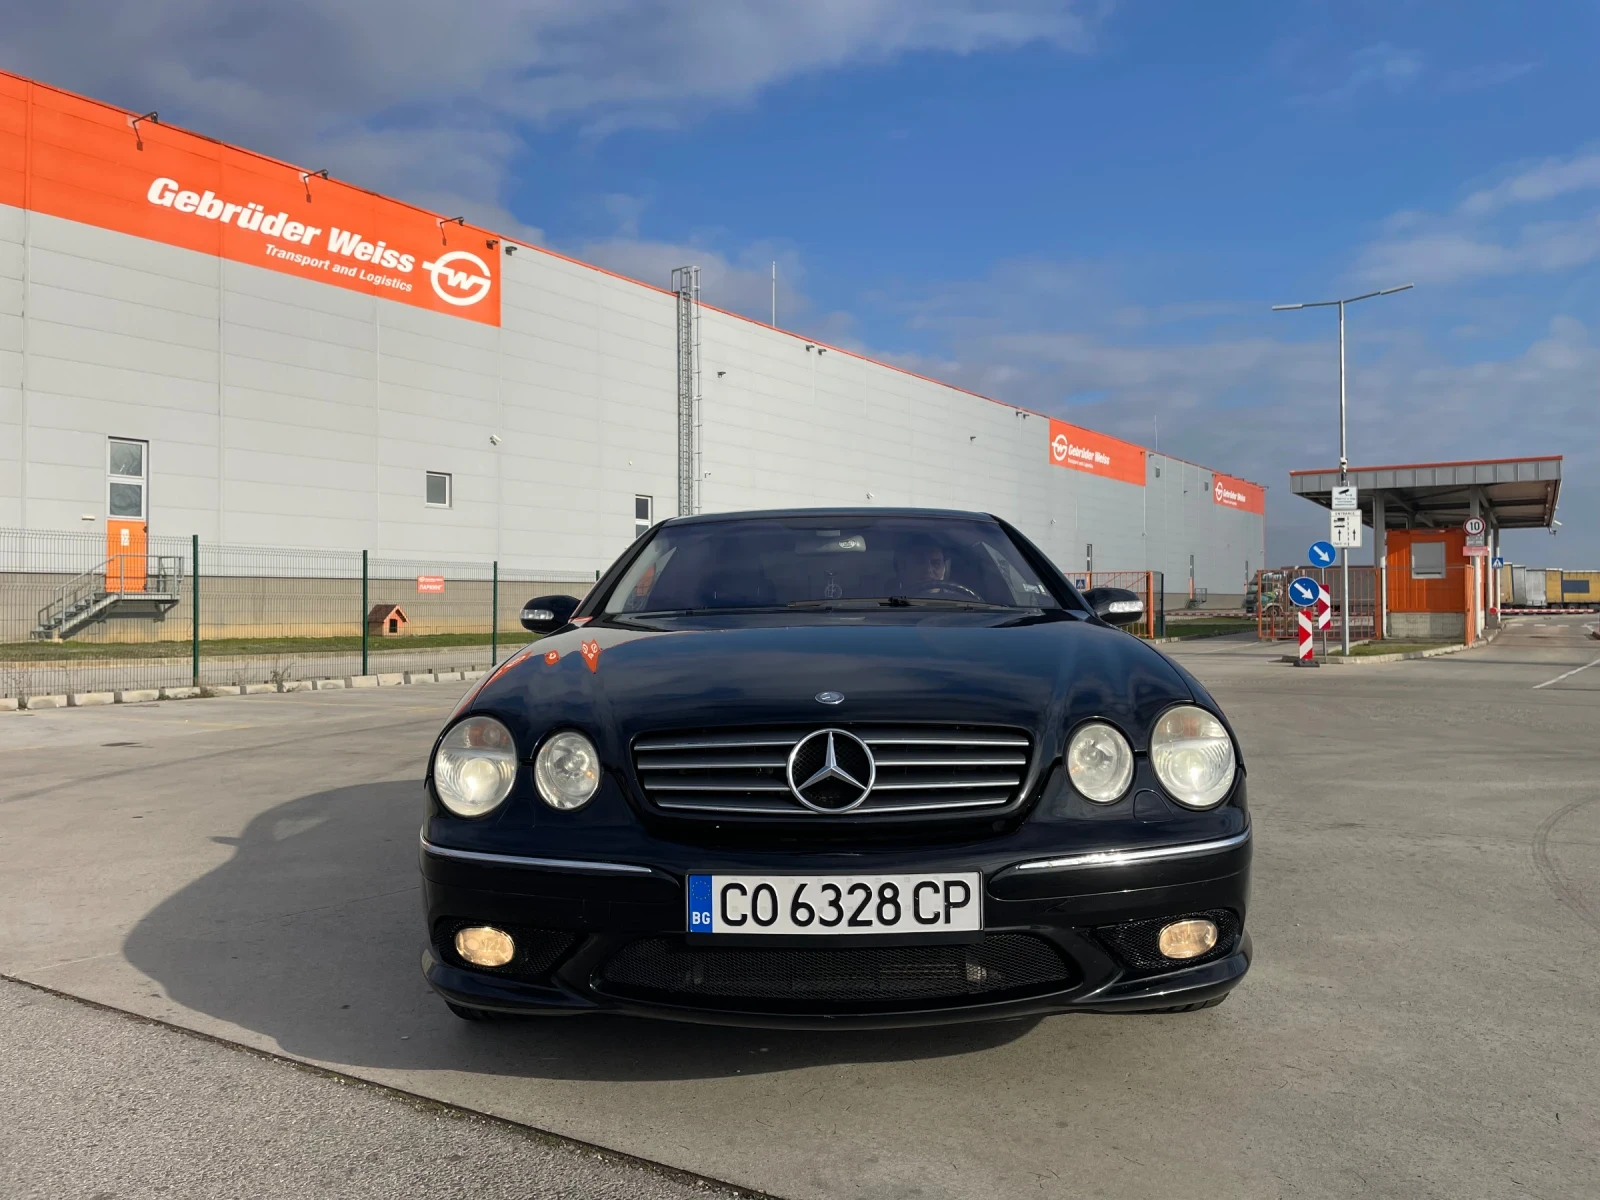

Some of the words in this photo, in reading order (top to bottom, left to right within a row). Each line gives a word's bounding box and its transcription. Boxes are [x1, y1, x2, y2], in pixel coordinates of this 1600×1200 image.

[147, 177, 322, 245] Gebrüder
[327, 227, 415, 273] Weiss
[265, 244, 330, 270] Transport
[332, 263, 358, 277] and
[359, 269, 413, 292] Logistics
[1068, 444, 1094, 461] Gebrüder
[1095, 451, 1110, 465] Weiss
[1470, 521, 1480, 531] 10
[692, 911, 711, 925] BG
[720, 882, 778, 927] CO
[790, 882, 901, 927] 6328
[913, 880, 971, 925] CP
